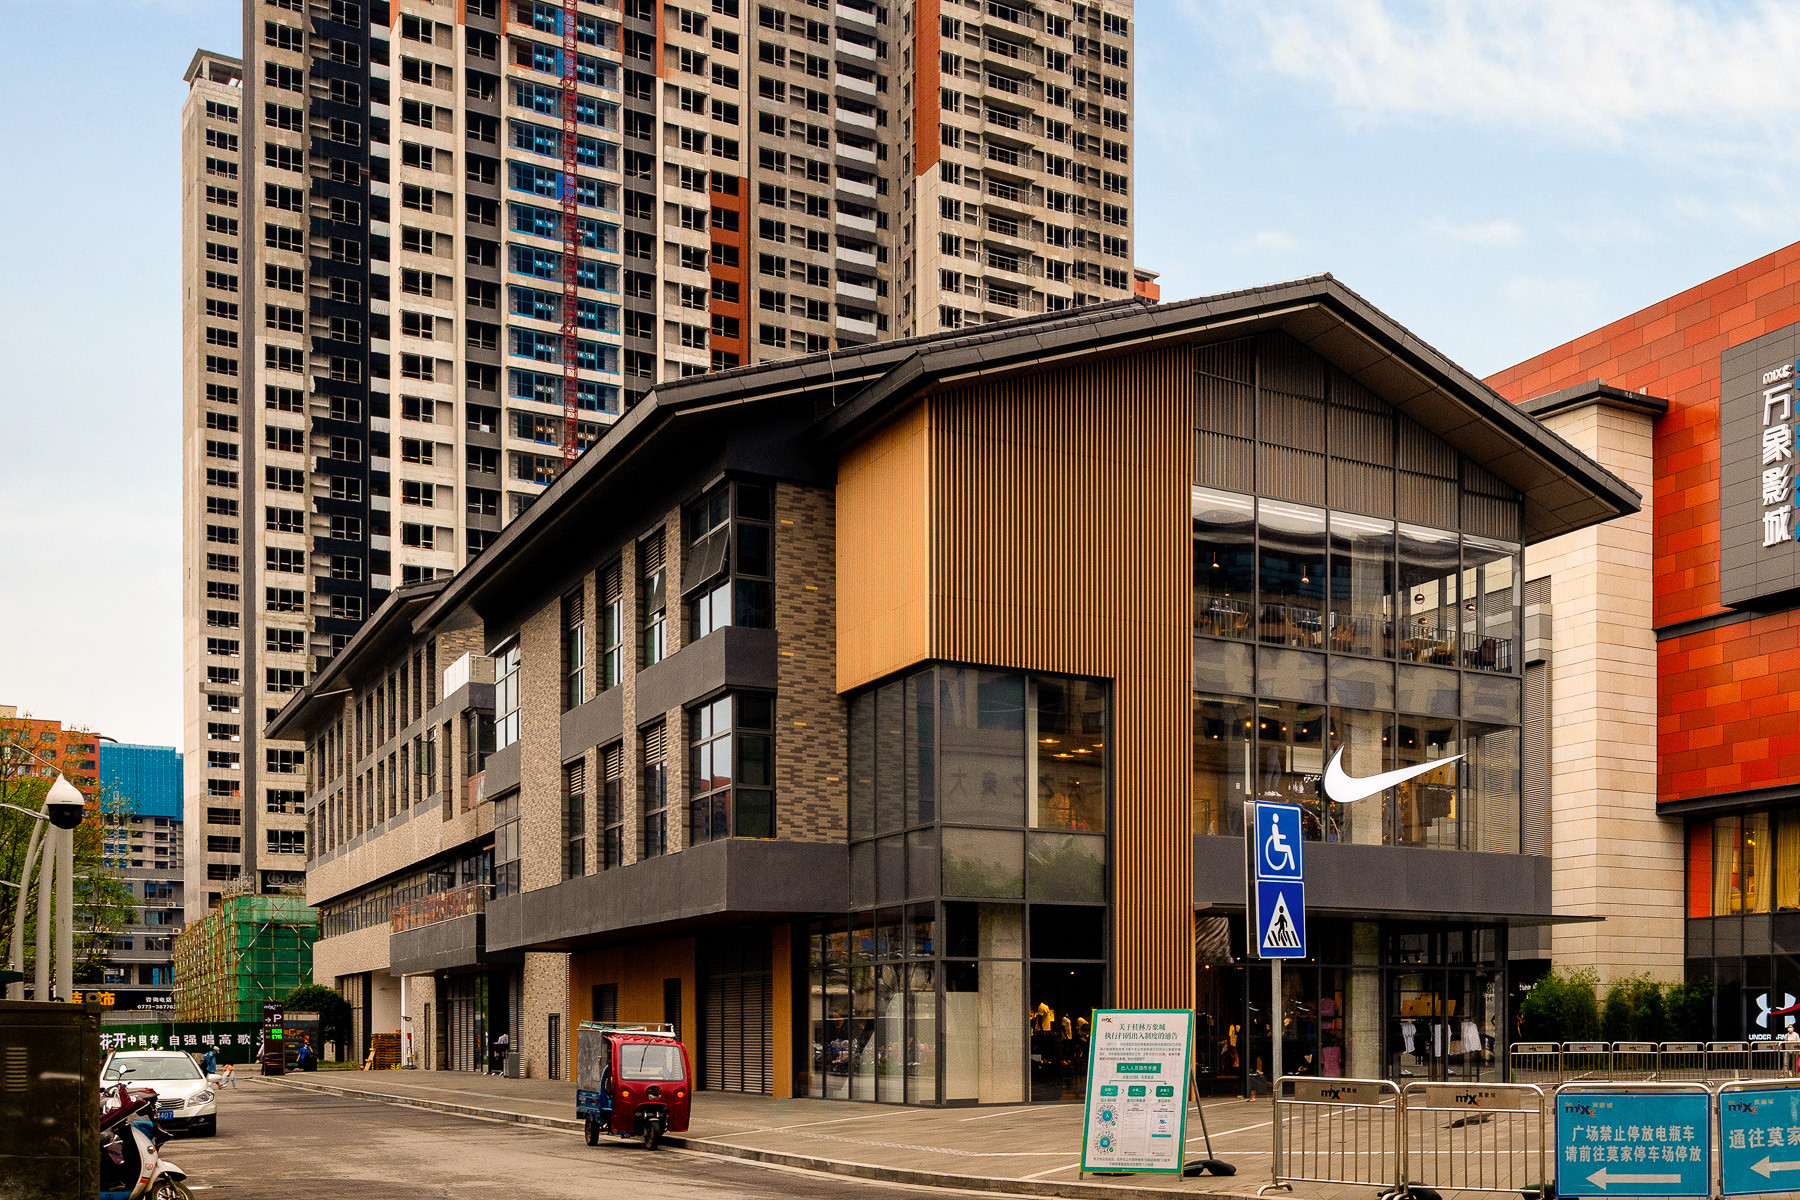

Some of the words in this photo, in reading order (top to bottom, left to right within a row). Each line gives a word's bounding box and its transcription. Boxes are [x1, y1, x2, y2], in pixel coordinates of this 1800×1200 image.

[1762, 382, 1793, 548] 万象影城
[273, 1014, 282, 1023] P
[1119, 1023, 1166, 1031] 关于桂林万象城
[169, 1034, 251, 1047] 自强唱高歌
[1104, 1032, 1178, 1040] 执行扫码出入制度的通告
[1572, 1125, 1695, 1142] 广场禁止停放电瓶车
[1565, 1145, 1701, 1162] 请前往莫家停车场停放
